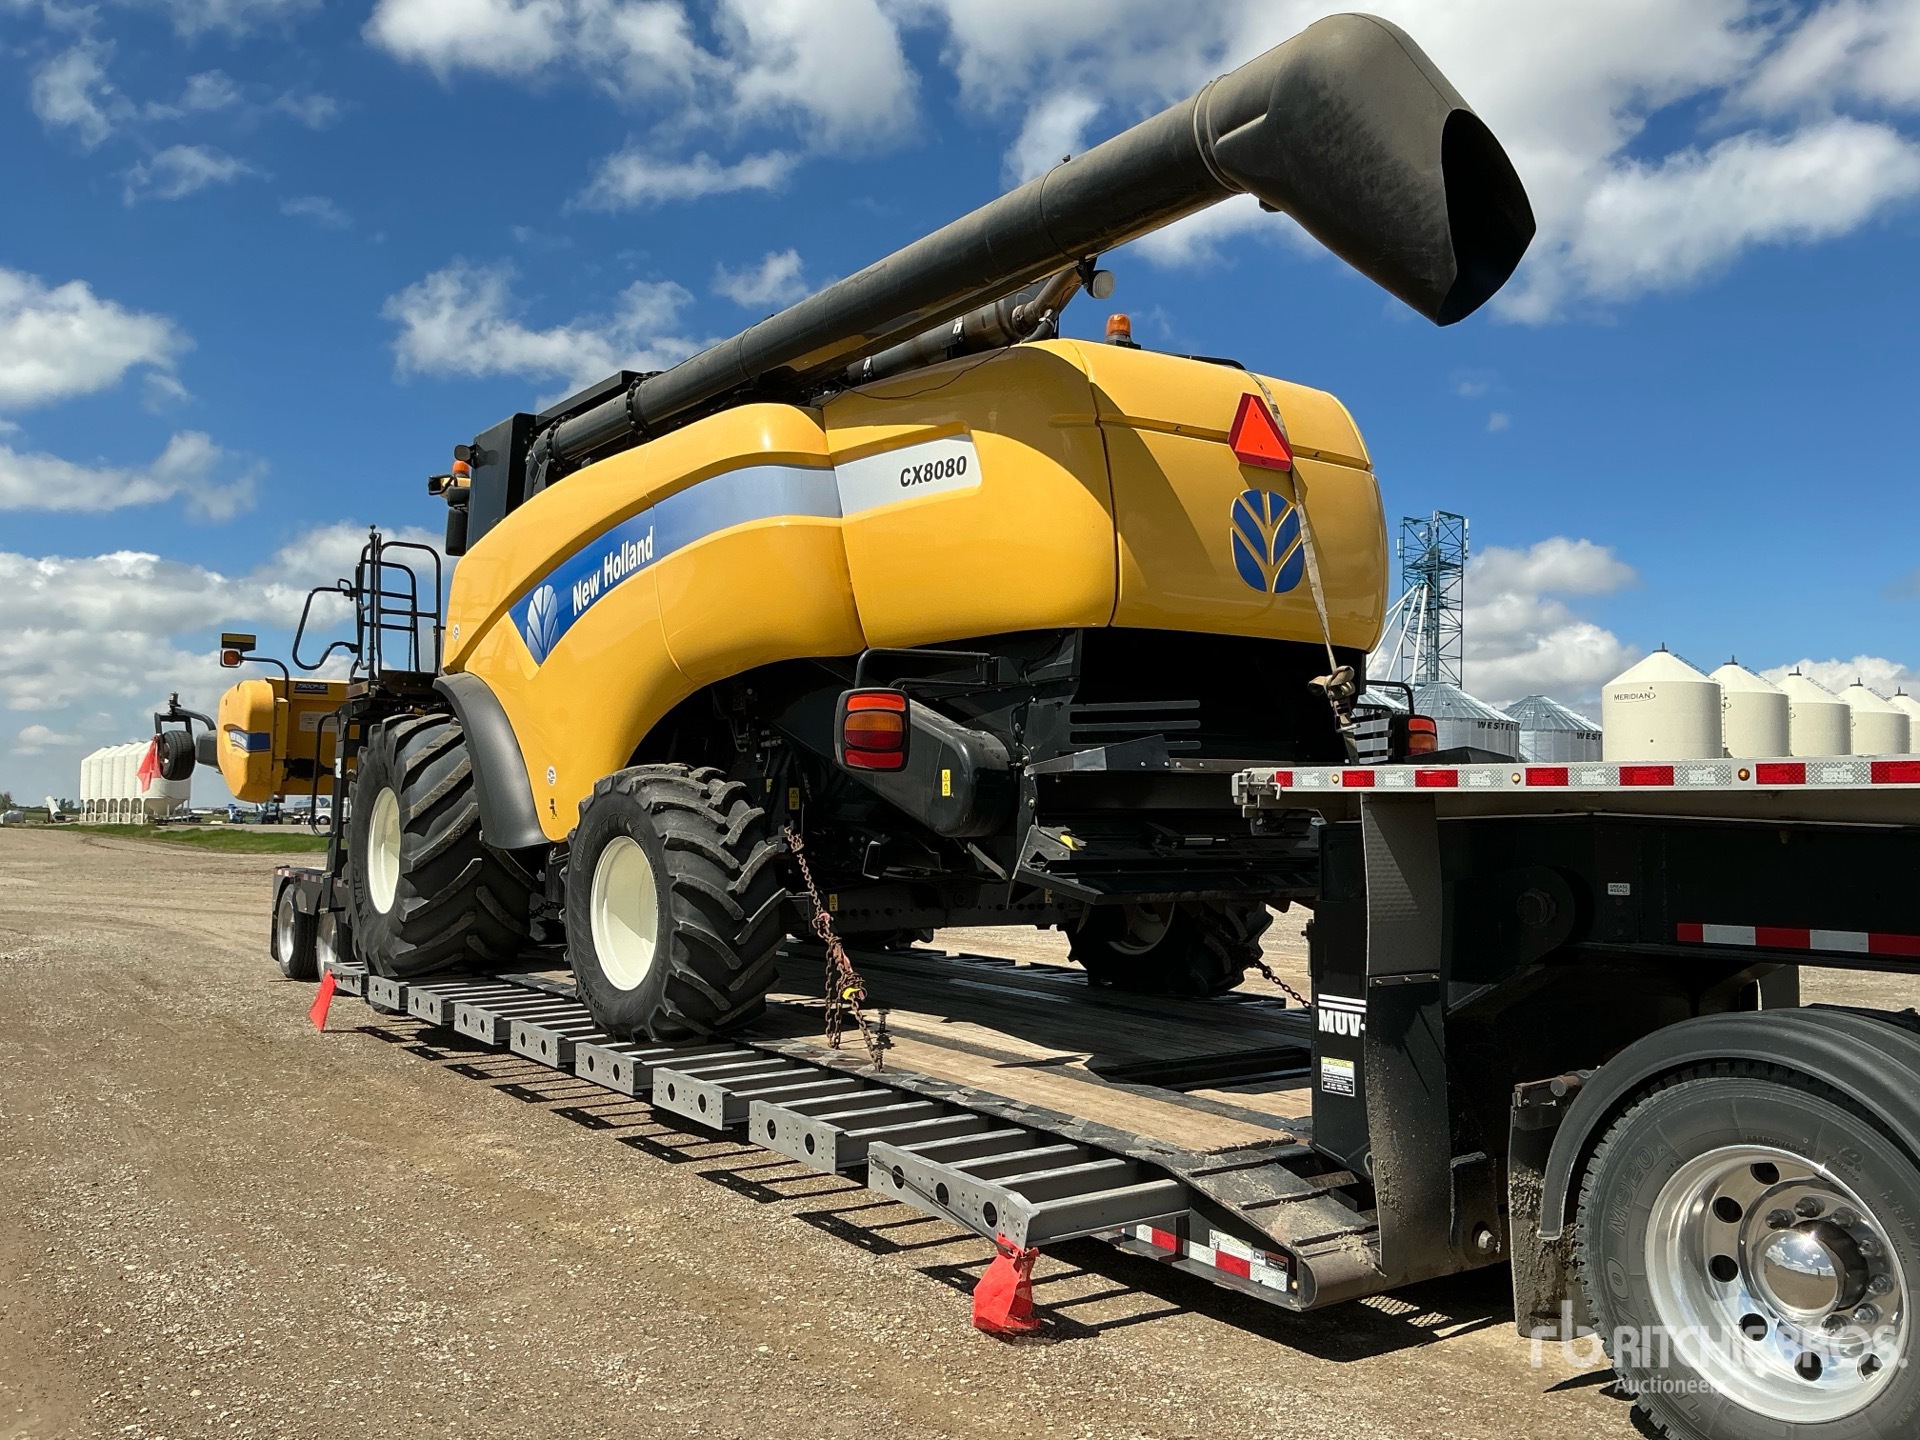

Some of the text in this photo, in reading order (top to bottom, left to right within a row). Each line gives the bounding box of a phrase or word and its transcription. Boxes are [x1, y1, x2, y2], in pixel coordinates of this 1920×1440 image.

[900, 456, 967, 487] CX8080
[573, 526, 653, 616] New Holland
[1614, 693, 1650, 701] MERIDIAN
[1576, 732, 1602, 741] WEST
